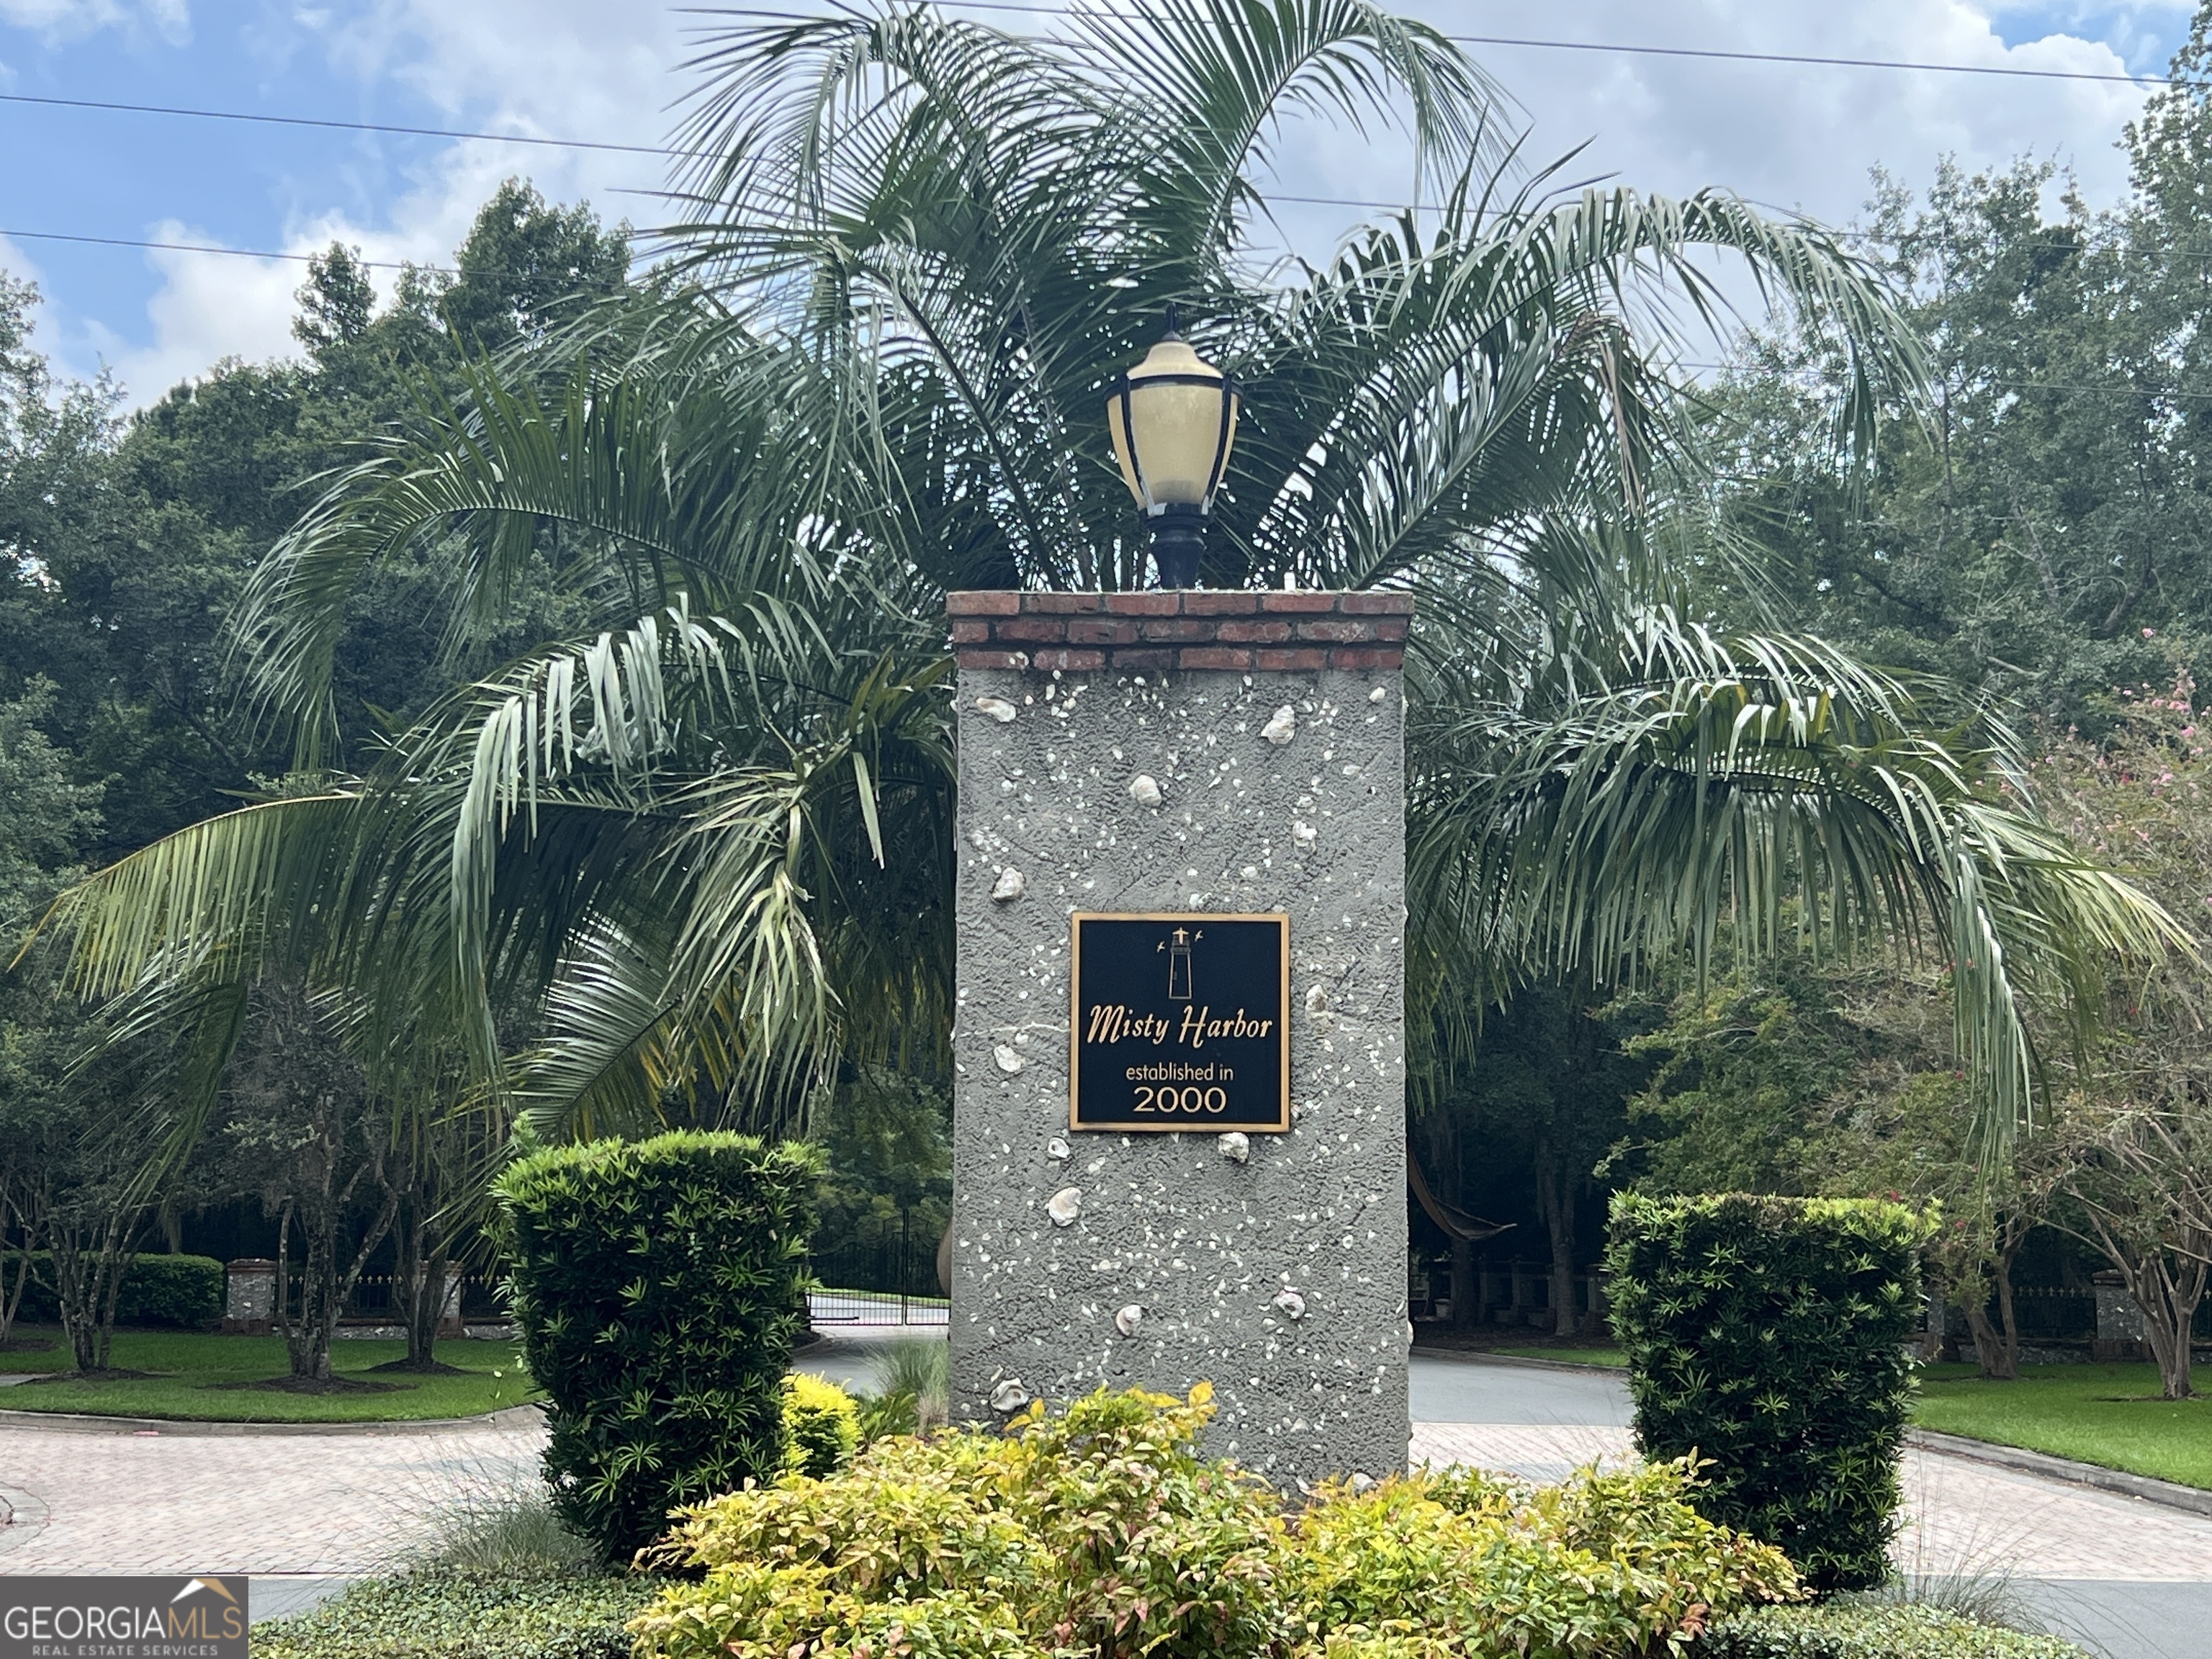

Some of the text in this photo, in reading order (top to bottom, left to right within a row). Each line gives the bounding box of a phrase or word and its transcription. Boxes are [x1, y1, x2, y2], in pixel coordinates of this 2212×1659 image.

[1087, 1005, 1272, 1048] Misty Harbor
[1125, 1062, 1233, 1081] established in
[1133, 1087, 1226, 1112] 2000
